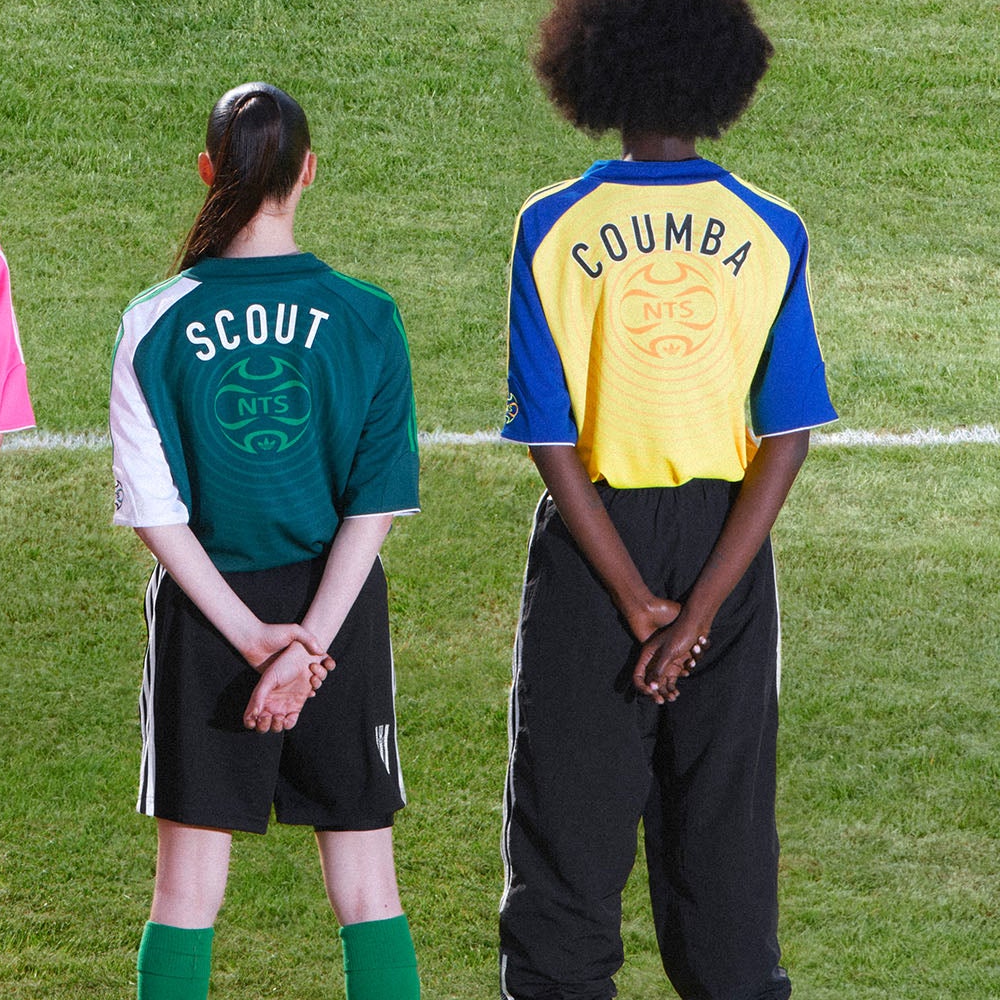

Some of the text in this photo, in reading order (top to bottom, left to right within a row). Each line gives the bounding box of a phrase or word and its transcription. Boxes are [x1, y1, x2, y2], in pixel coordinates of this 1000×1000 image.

[571, 212, 752, 279] COUMBA
[643, 300, 695, 321] NTS
[186, 303, 330, 361] SCOUT
[237, 395, 290, 416] NTS
